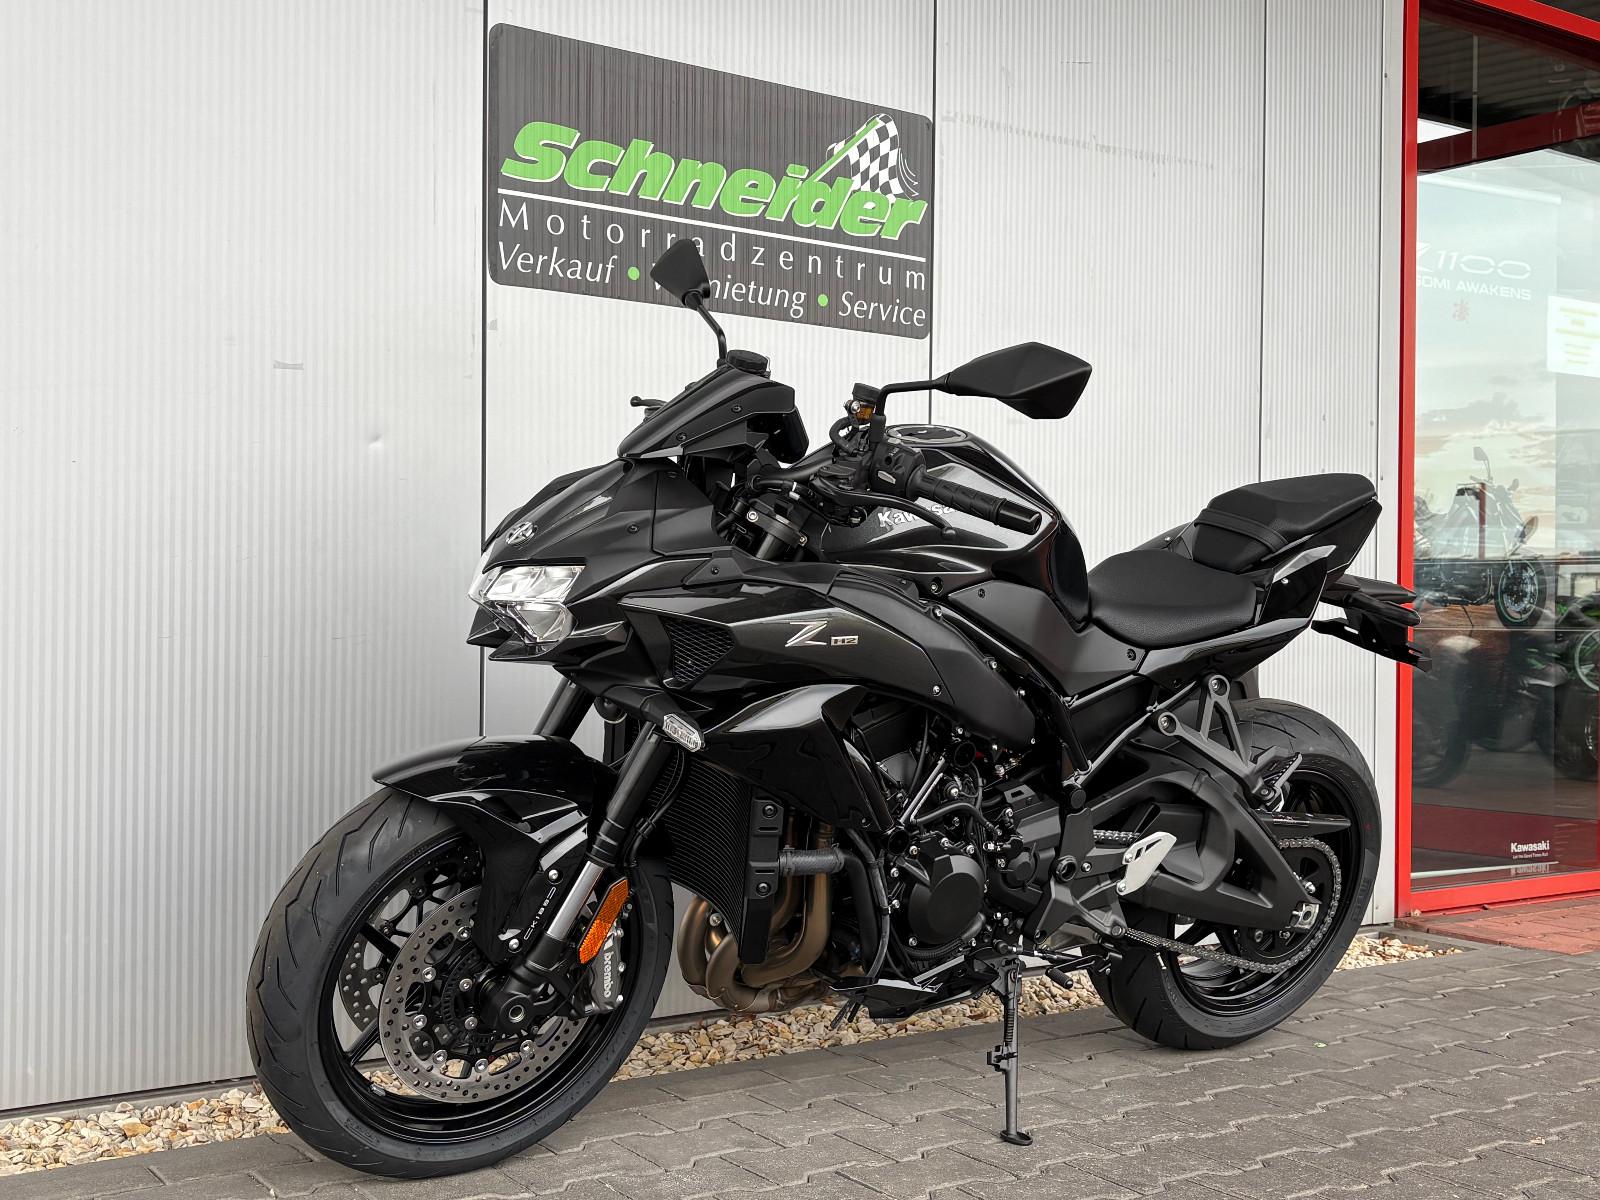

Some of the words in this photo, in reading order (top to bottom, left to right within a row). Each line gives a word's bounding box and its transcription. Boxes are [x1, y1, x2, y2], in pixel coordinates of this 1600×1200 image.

[500, 120, 928, 240] Schneider
[499, 198, 926, 291] Motorradzentrum
[498, 241, 618, 284] Verkauf
[652, 263, 806, 319] mietung
[838, 291, 926, 327] Service
[1455, 280, 1531, 301] AWAKENS
[785, 621, 827, 647] Z
[832, 636, 857, 645] H2
[1510, 840, 1550, 853] Kawasaki
[603, 951, 614, 998] brembo
